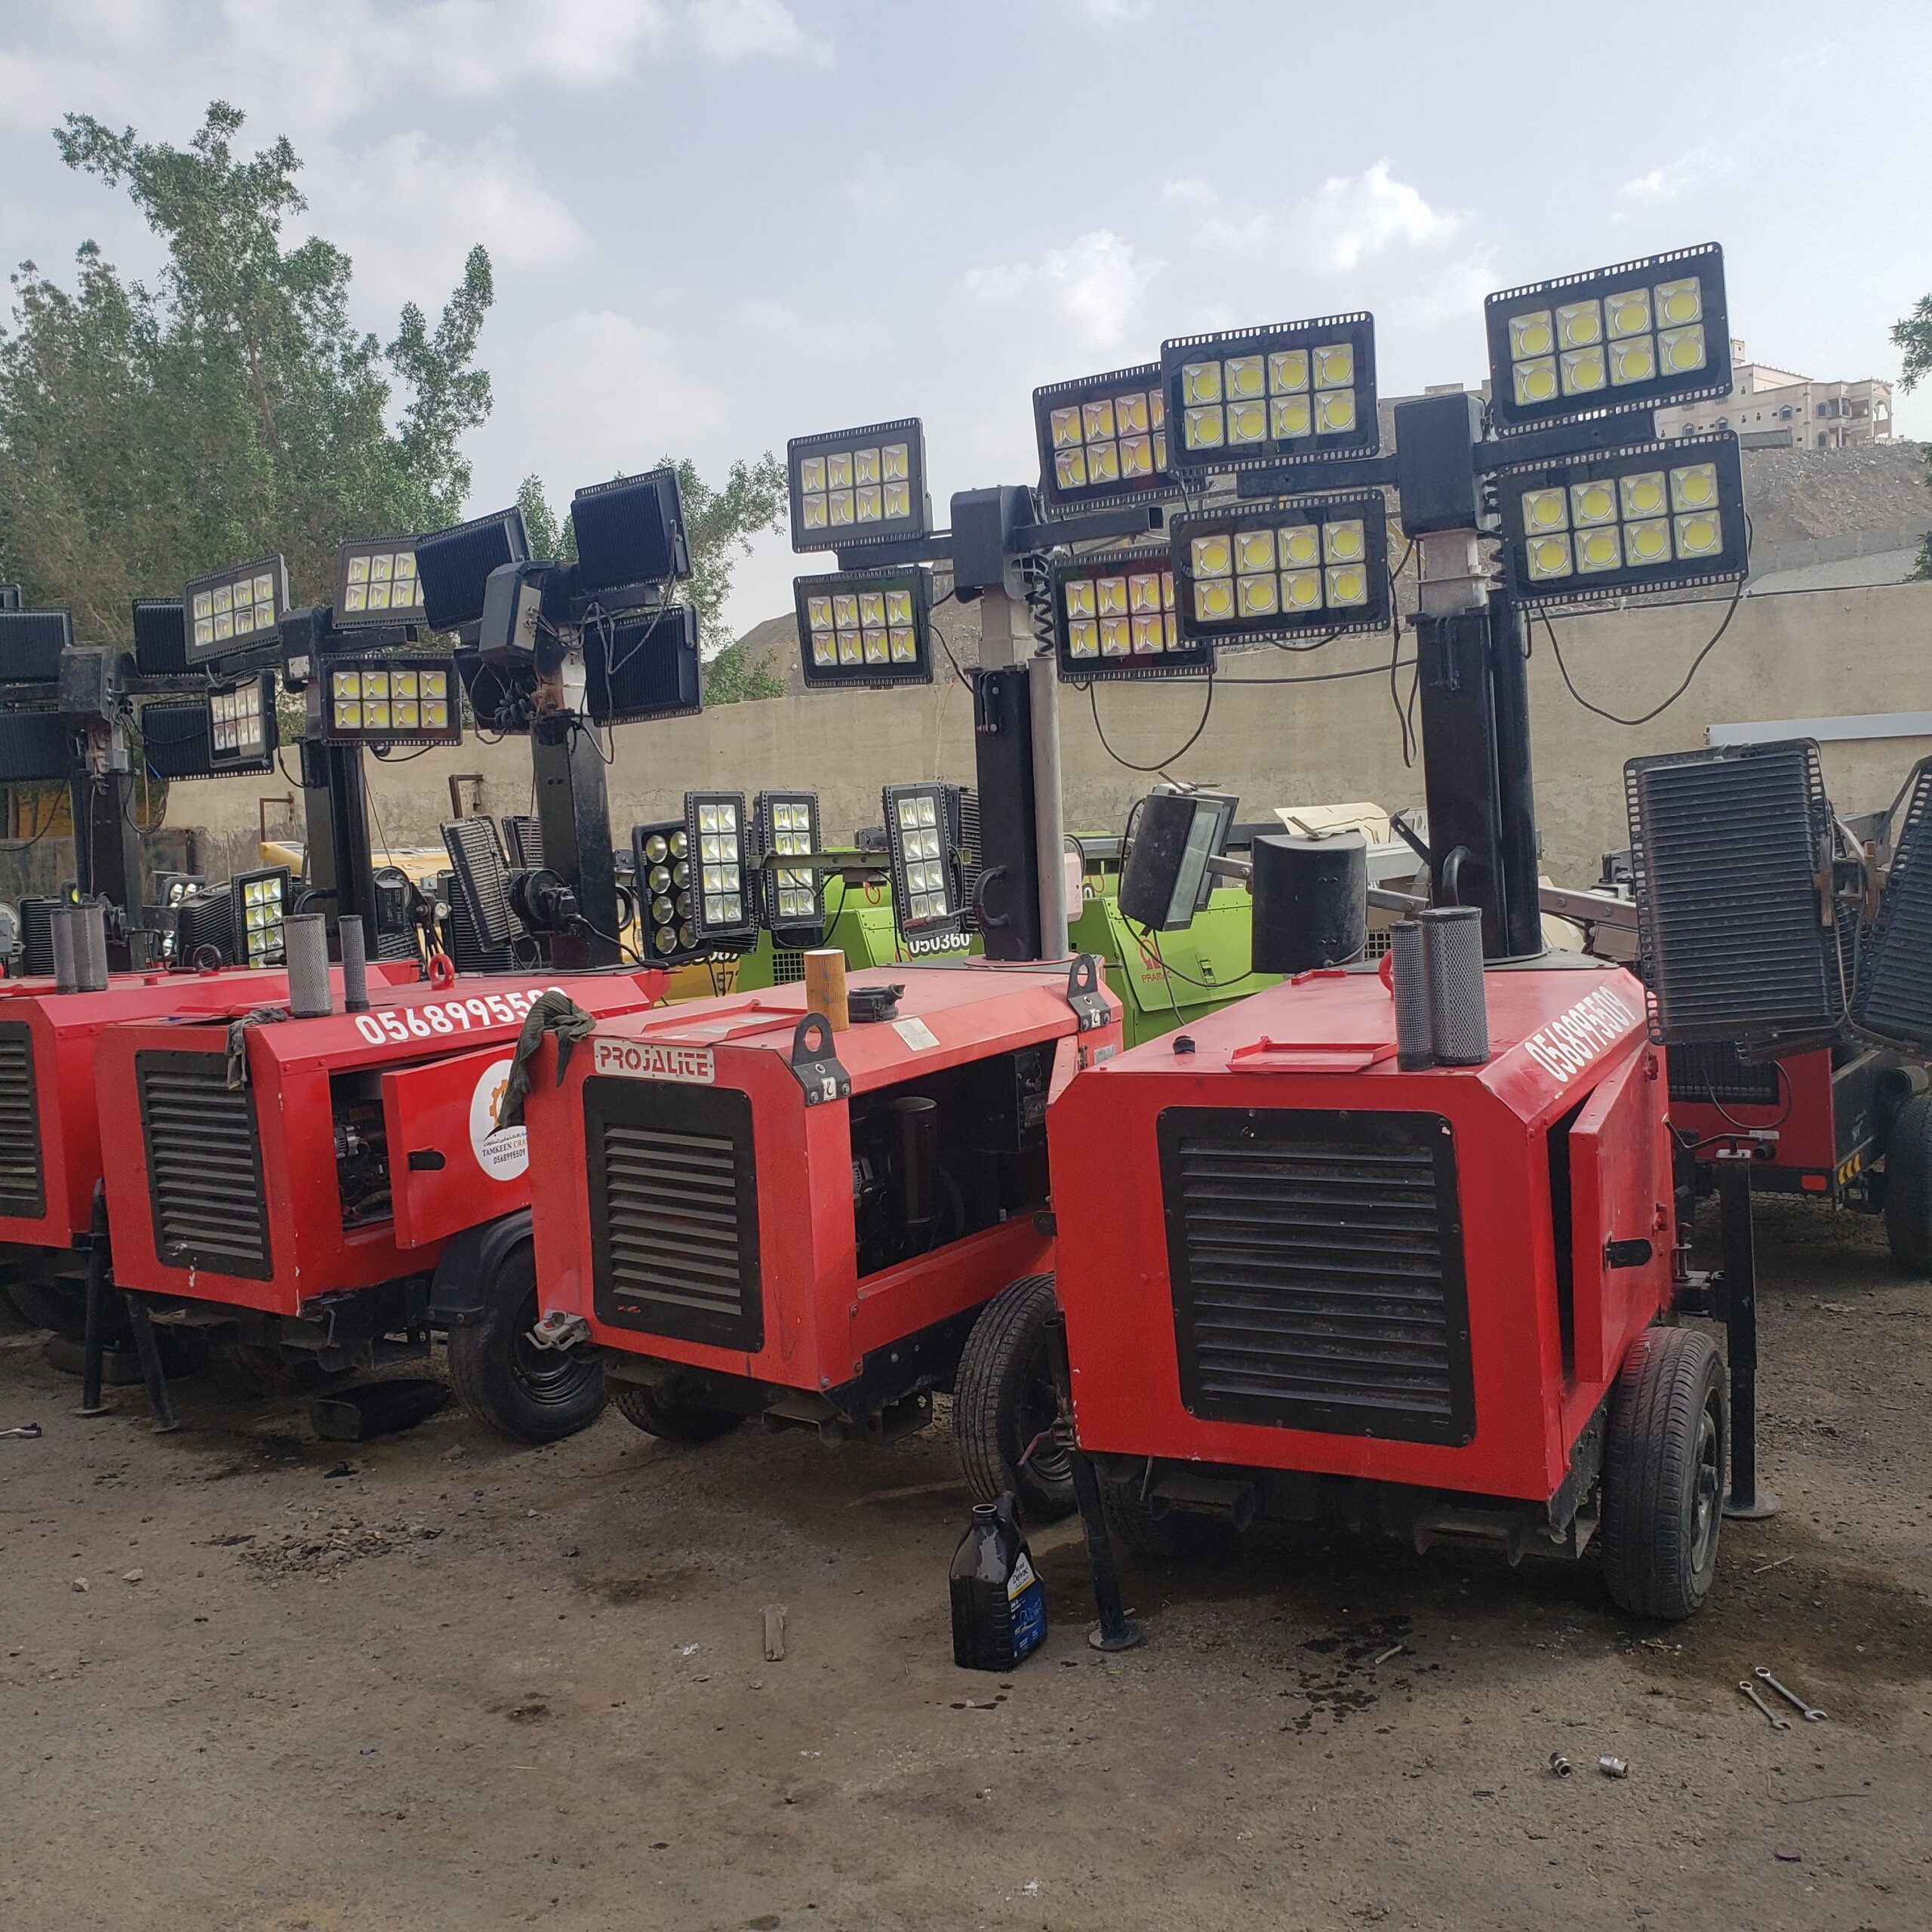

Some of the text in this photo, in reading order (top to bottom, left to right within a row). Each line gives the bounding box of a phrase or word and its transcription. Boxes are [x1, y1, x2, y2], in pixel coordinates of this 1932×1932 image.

[909, 934, 973, 954] 050360
[355, 987, 568, 1044] 05689955
[1524, 986, 1636, 1082] 0568995509
[482, 1142, 512, 1157] TAMKEEN
[494, 1149, 526, 1164] 0568995509
